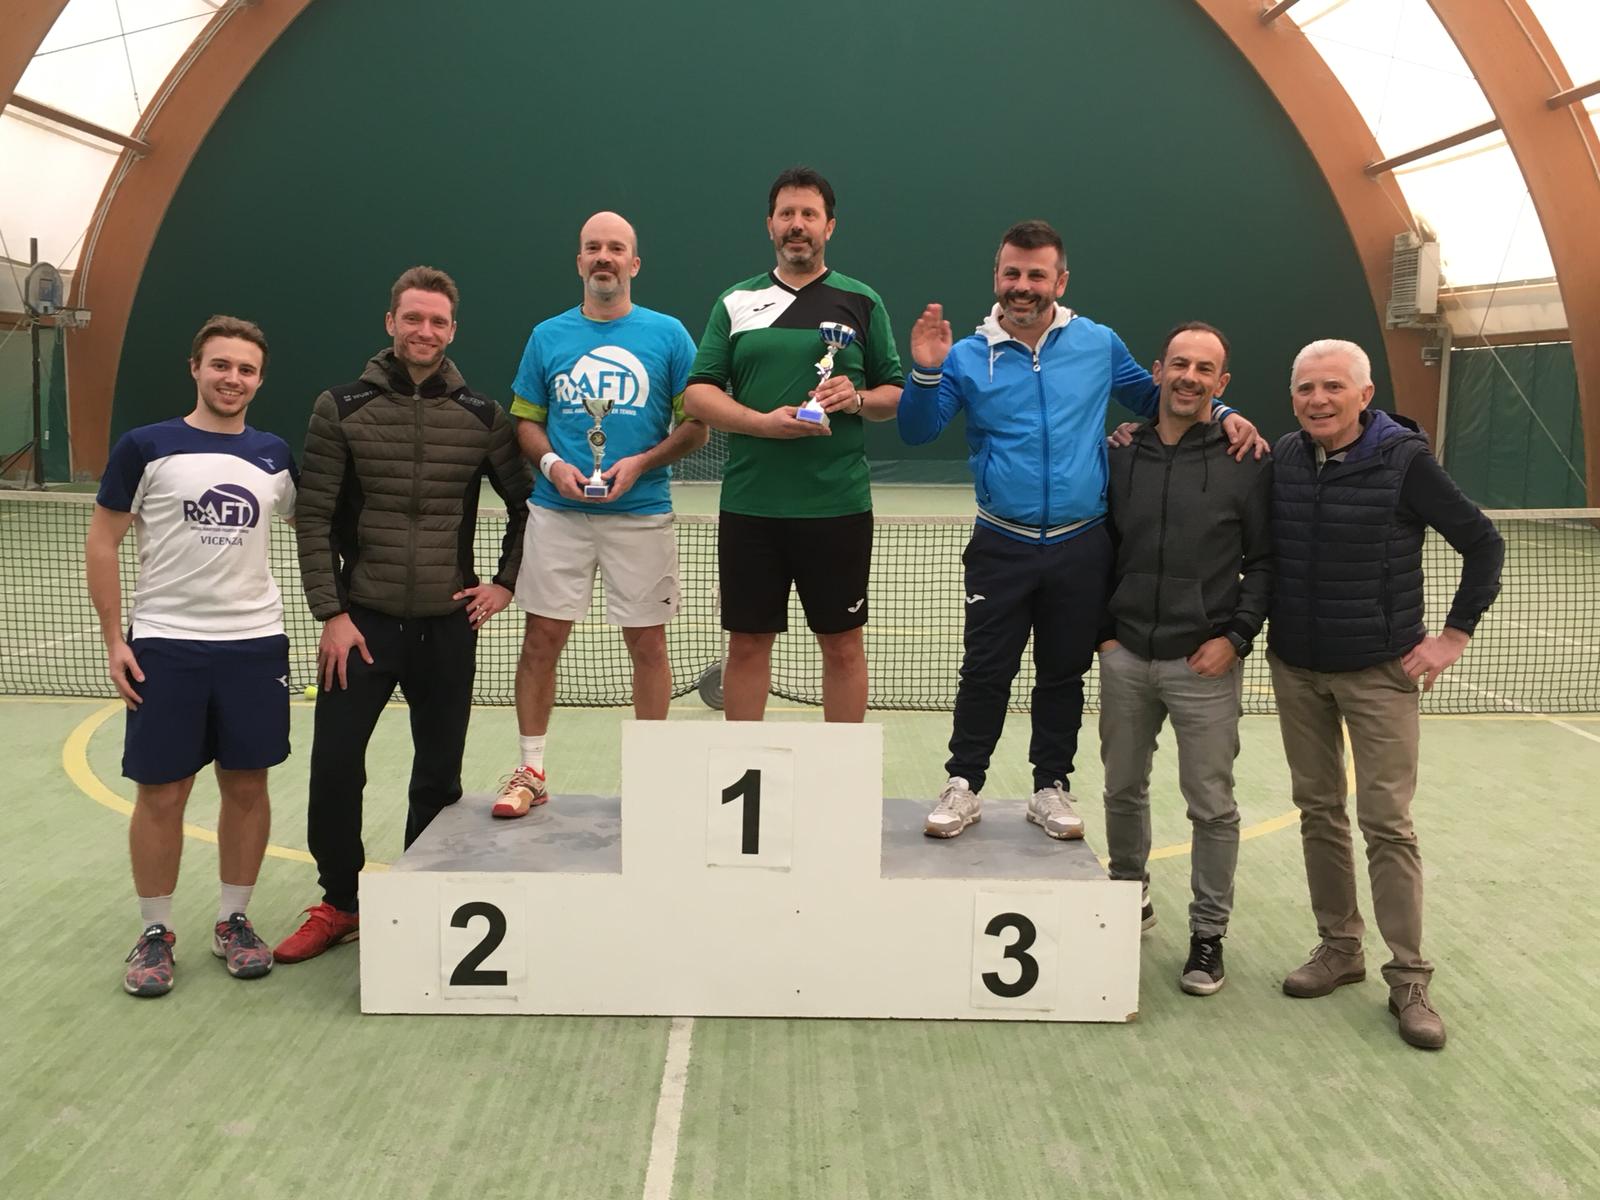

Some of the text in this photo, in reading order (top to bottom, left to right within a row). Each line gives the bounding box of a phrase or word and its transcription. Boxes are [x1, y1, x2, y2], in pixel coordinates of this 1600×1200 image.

[200, 535, 243, 546] VICENZA
[721, 769, 761, 855] 1
[449, 901, 508, 986] 2
[981, 912, 1039, 998] 3
